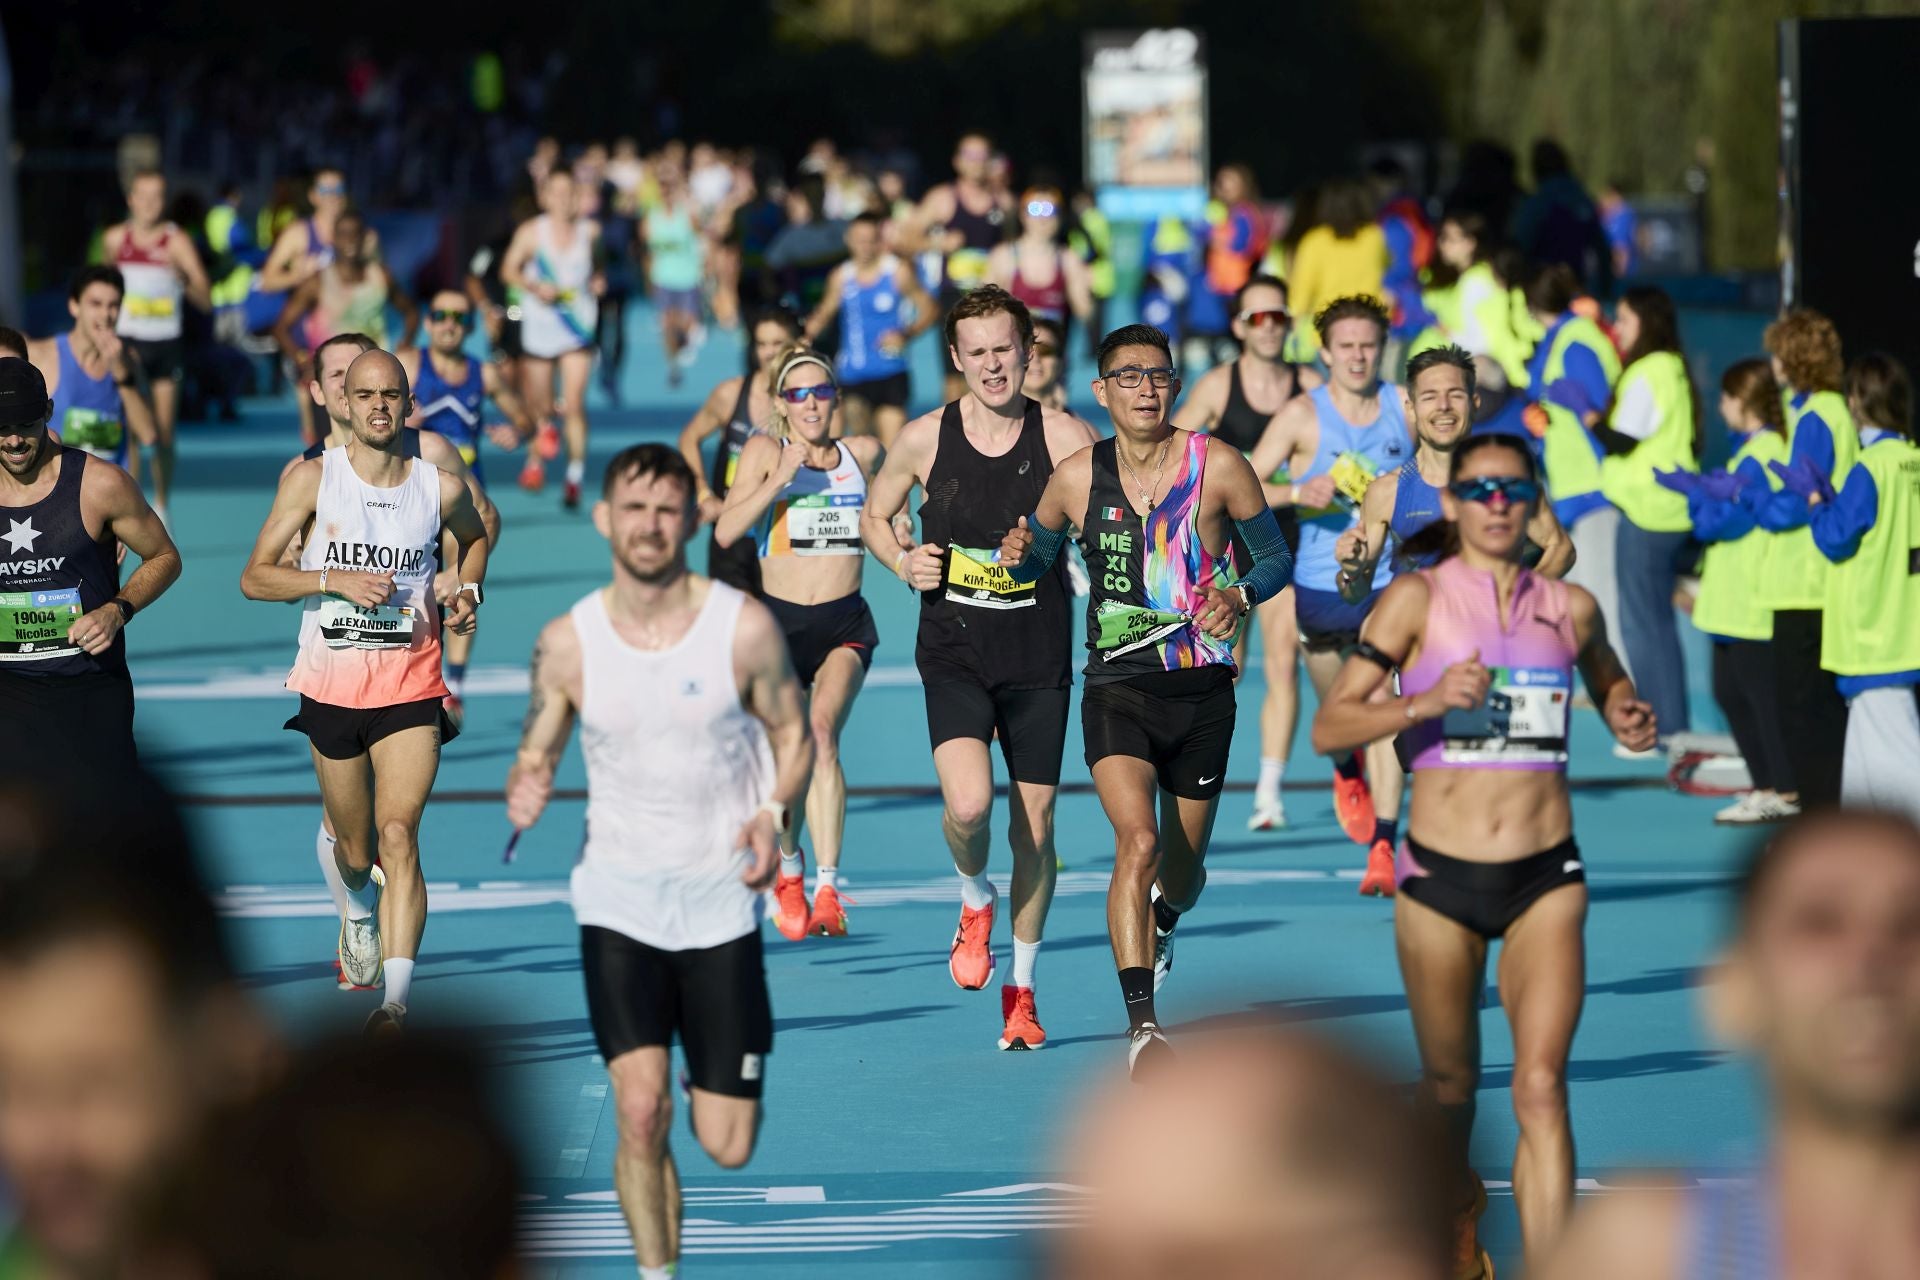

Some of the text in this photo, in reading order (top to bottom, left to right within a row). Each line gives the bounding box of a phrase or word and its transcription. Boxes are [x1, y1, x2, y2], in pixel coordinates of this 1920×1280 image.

[366, 501, 391, 509] CRAFT
[818, 512, 840, 522] 205
[818, 526, 850, 536] AMATO
[1099, 530, 1132, 554] MÉ
[0, 556, 66, 576] AYSKY
[1105, 554, 1127, 573] XI
[1103, 573, 1132, 593] CO
[13, 610, 56, 625] 19004
[331, 617, 398, 631] ALEXANDER
[15, 627, 58, 640] Nicolas
